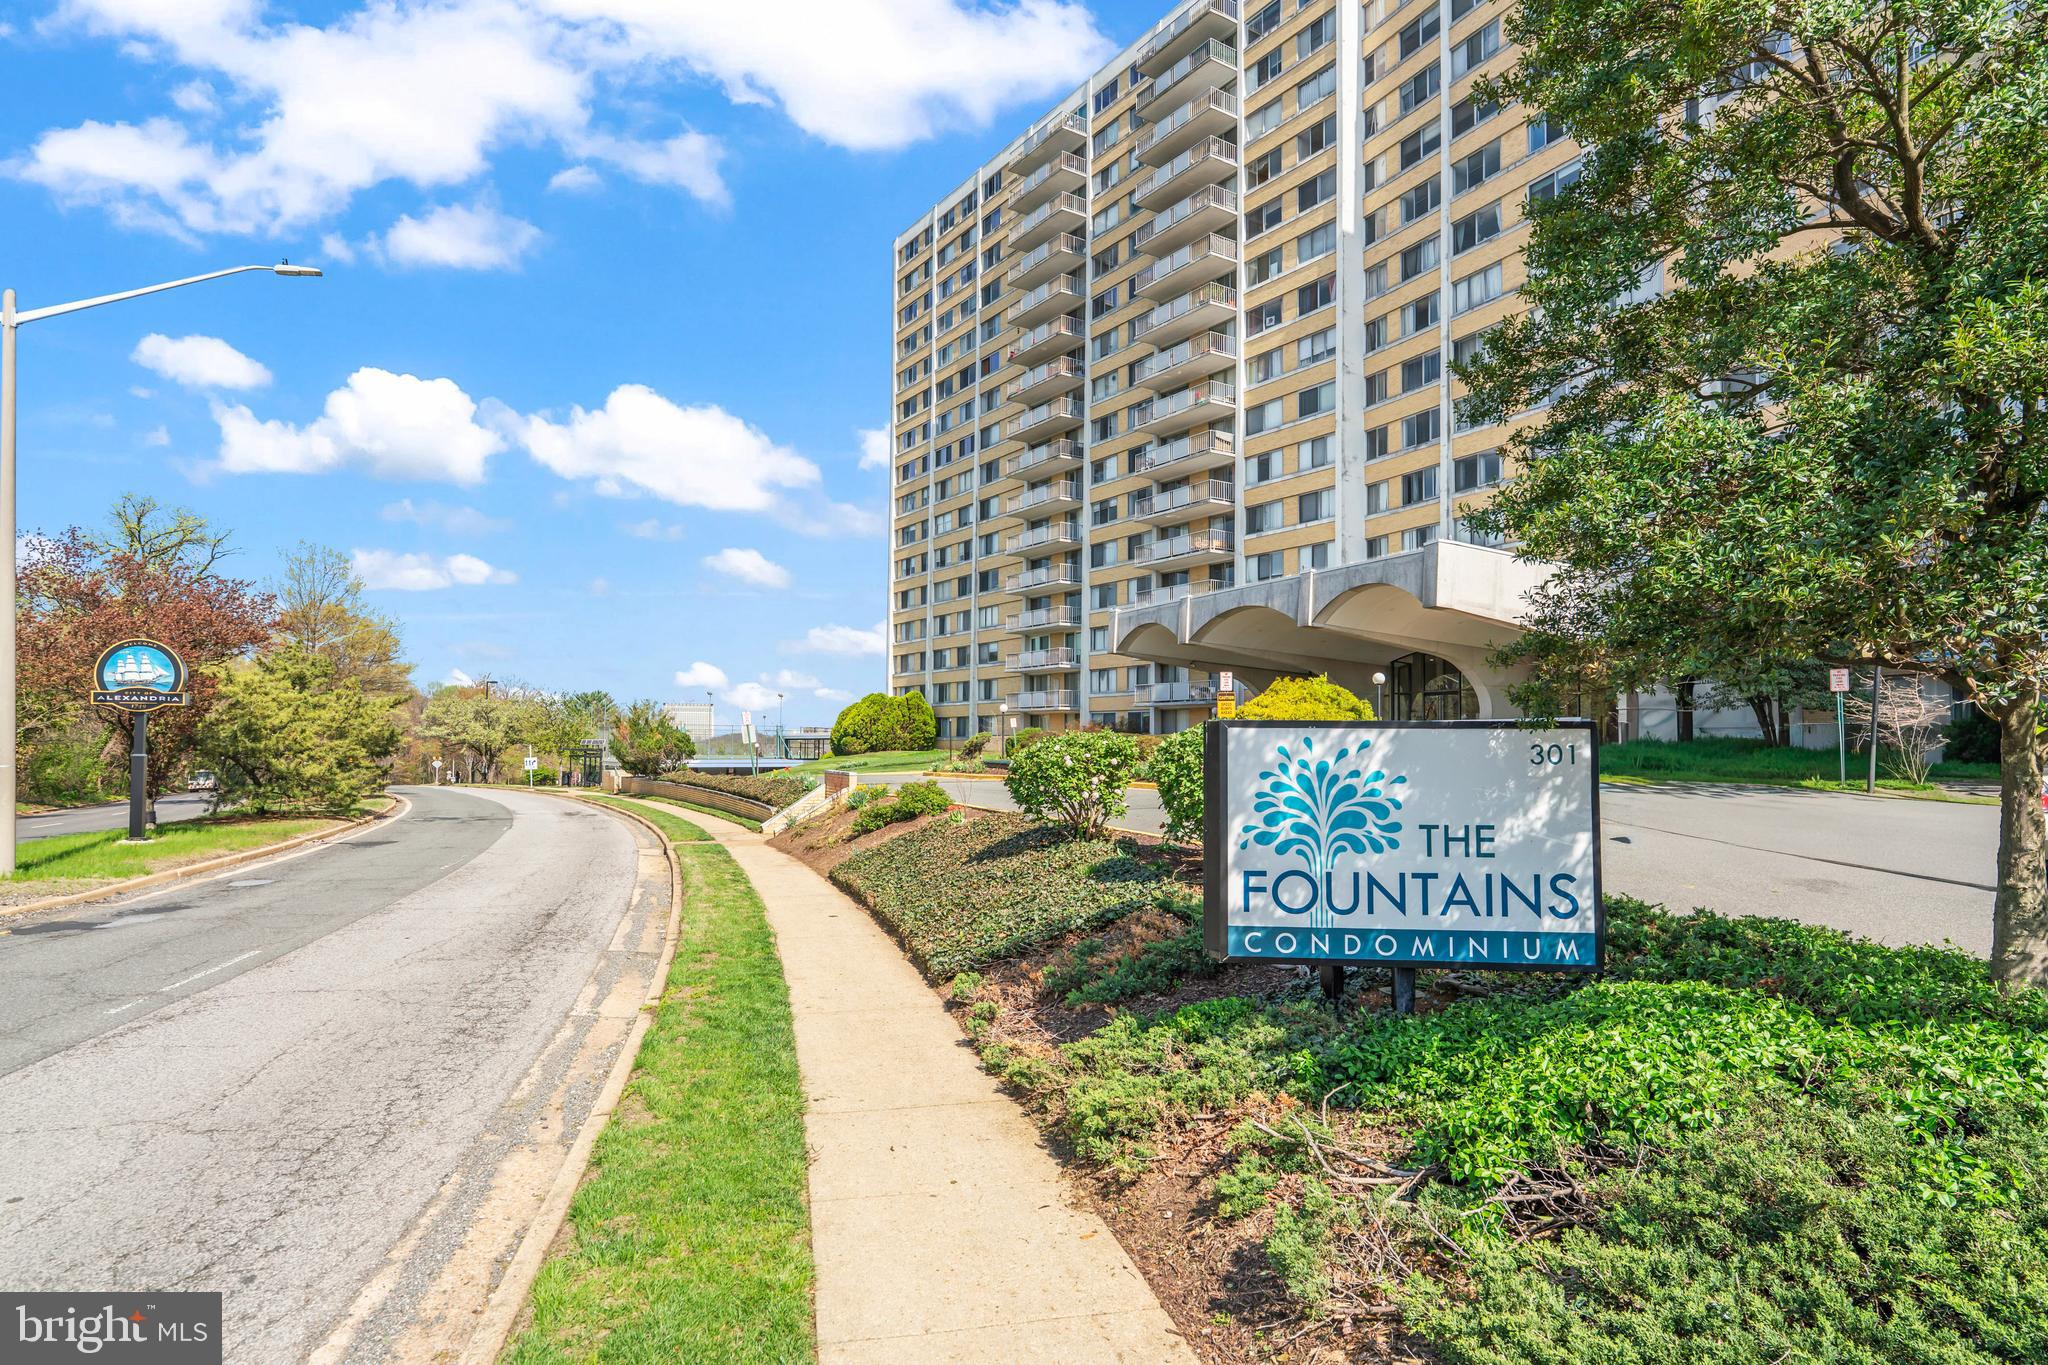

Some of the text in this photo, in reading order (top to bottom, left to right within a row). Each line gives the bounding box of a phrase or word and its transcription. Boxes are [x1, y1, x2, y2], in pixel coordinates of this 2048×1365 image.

[1530, 744, 1576, 766] 301
[1418, 824, 1496, 859] THE
[1243, 869, 1580, 919] FOUNTAINS
[1244, 931, 1580, 961] CONDOMINIUM
